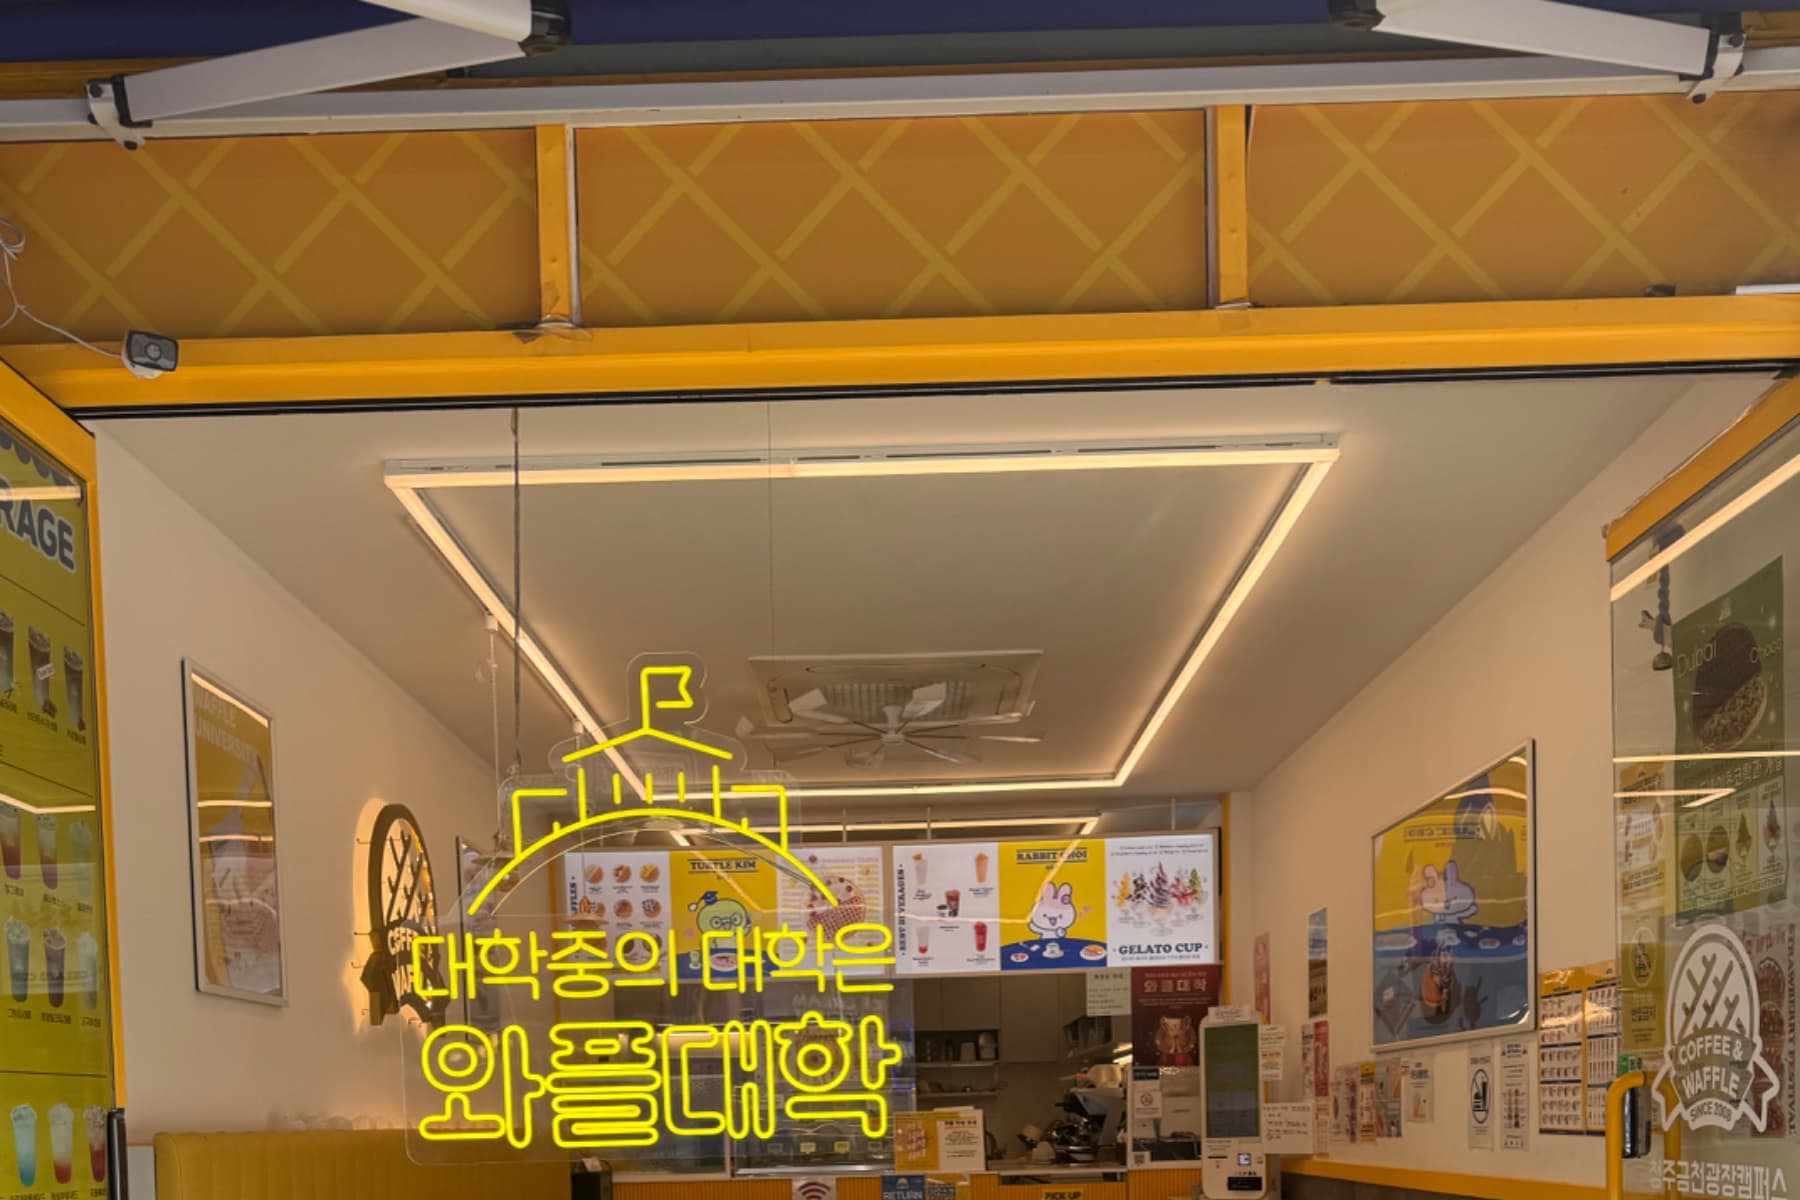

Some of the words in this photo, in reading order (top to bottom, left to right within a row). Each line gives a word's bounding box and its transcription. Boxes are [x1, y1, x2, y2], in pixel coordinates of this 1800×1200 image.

[1016, 851, 1057, 861] RABBIT
[1118, 943, 1175, 955] GELATO
[1177, 942, 1203, 953] CUP
[411, 928, 679, 1000] 대학중의
[702, 923, 895, 994] 대학은
[1678, 1034, 1731, 1065] COFFEE
[1733, 1038, 1744, 1062] &
[418, 1010, 903, 1149] 와플대학
[1681, 1066, 1741, 1099] WAFFLE
[882, 1190, 923, 1200] RETURN
[1067, 1190, 1083, 1200] UP
